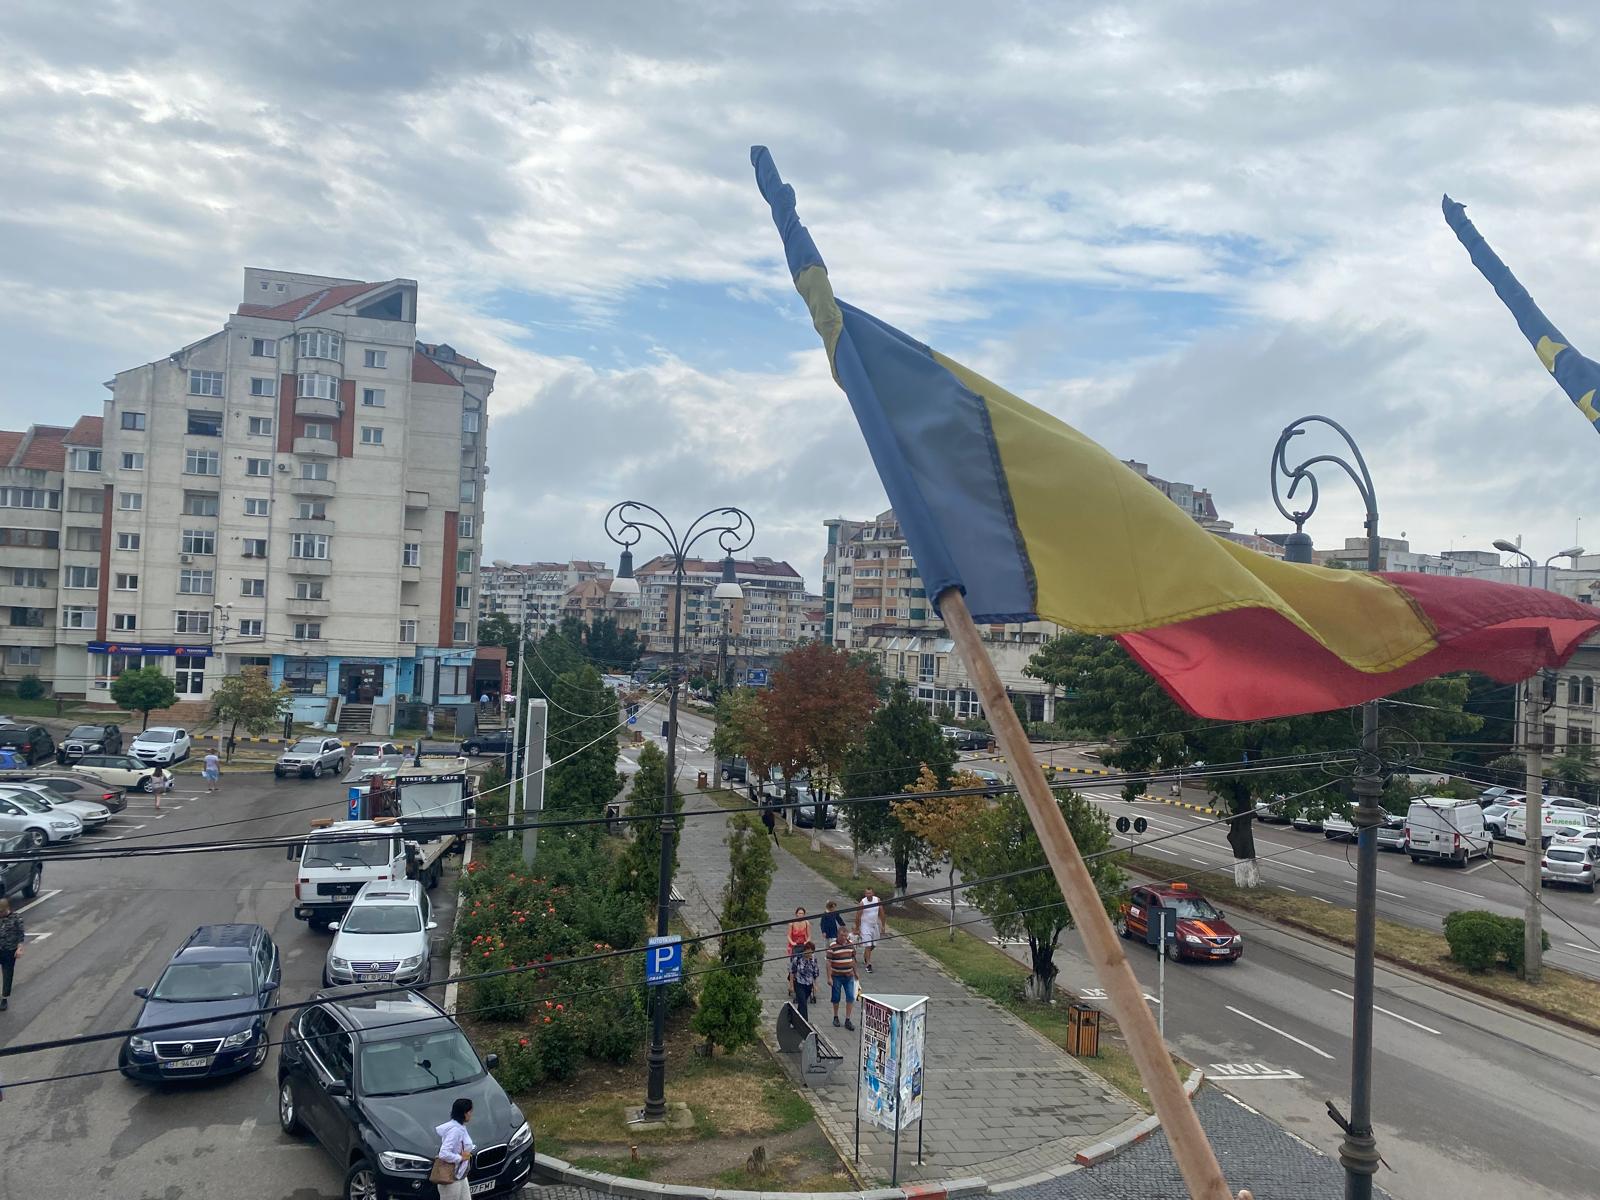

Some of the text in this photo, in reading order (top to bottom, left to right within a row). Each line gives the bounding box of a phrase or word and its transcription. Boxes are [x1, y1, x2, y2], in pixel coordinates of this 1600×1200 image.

[655, 946, 674, 973] P
[1209, 1063, 1283, 1075] TAXI
[479, 1181, 494, 1191] FMT
